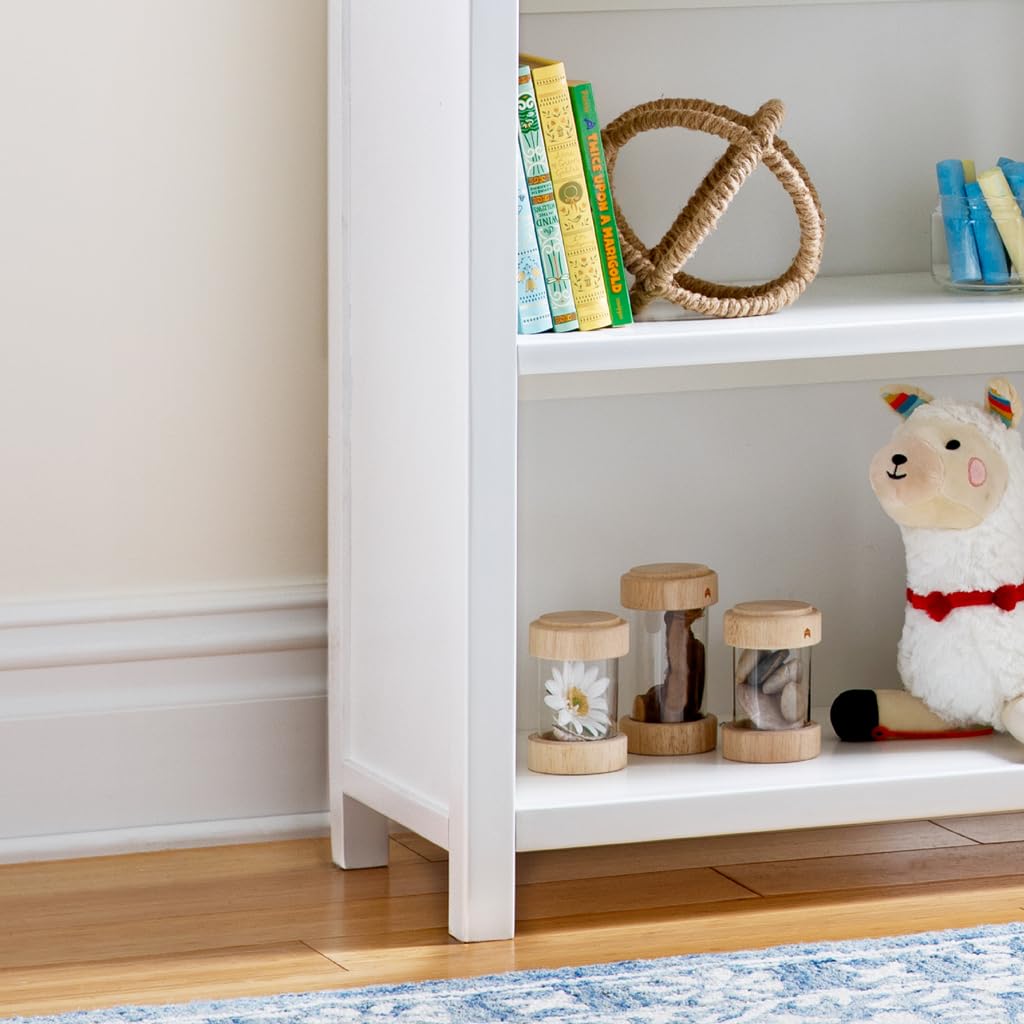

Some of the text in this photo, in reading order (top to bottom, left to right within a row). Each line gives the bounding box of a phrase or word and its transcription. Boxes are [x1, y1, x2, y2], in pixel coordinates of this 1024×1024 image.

[587, 133, 602, 172] TWICE
[593, 174, 609, 211] UPON
[536, 215, 559, 227] WIND
[600, 214, 611, 225] A
[602, 226, 622, 293] MARIGOLD
